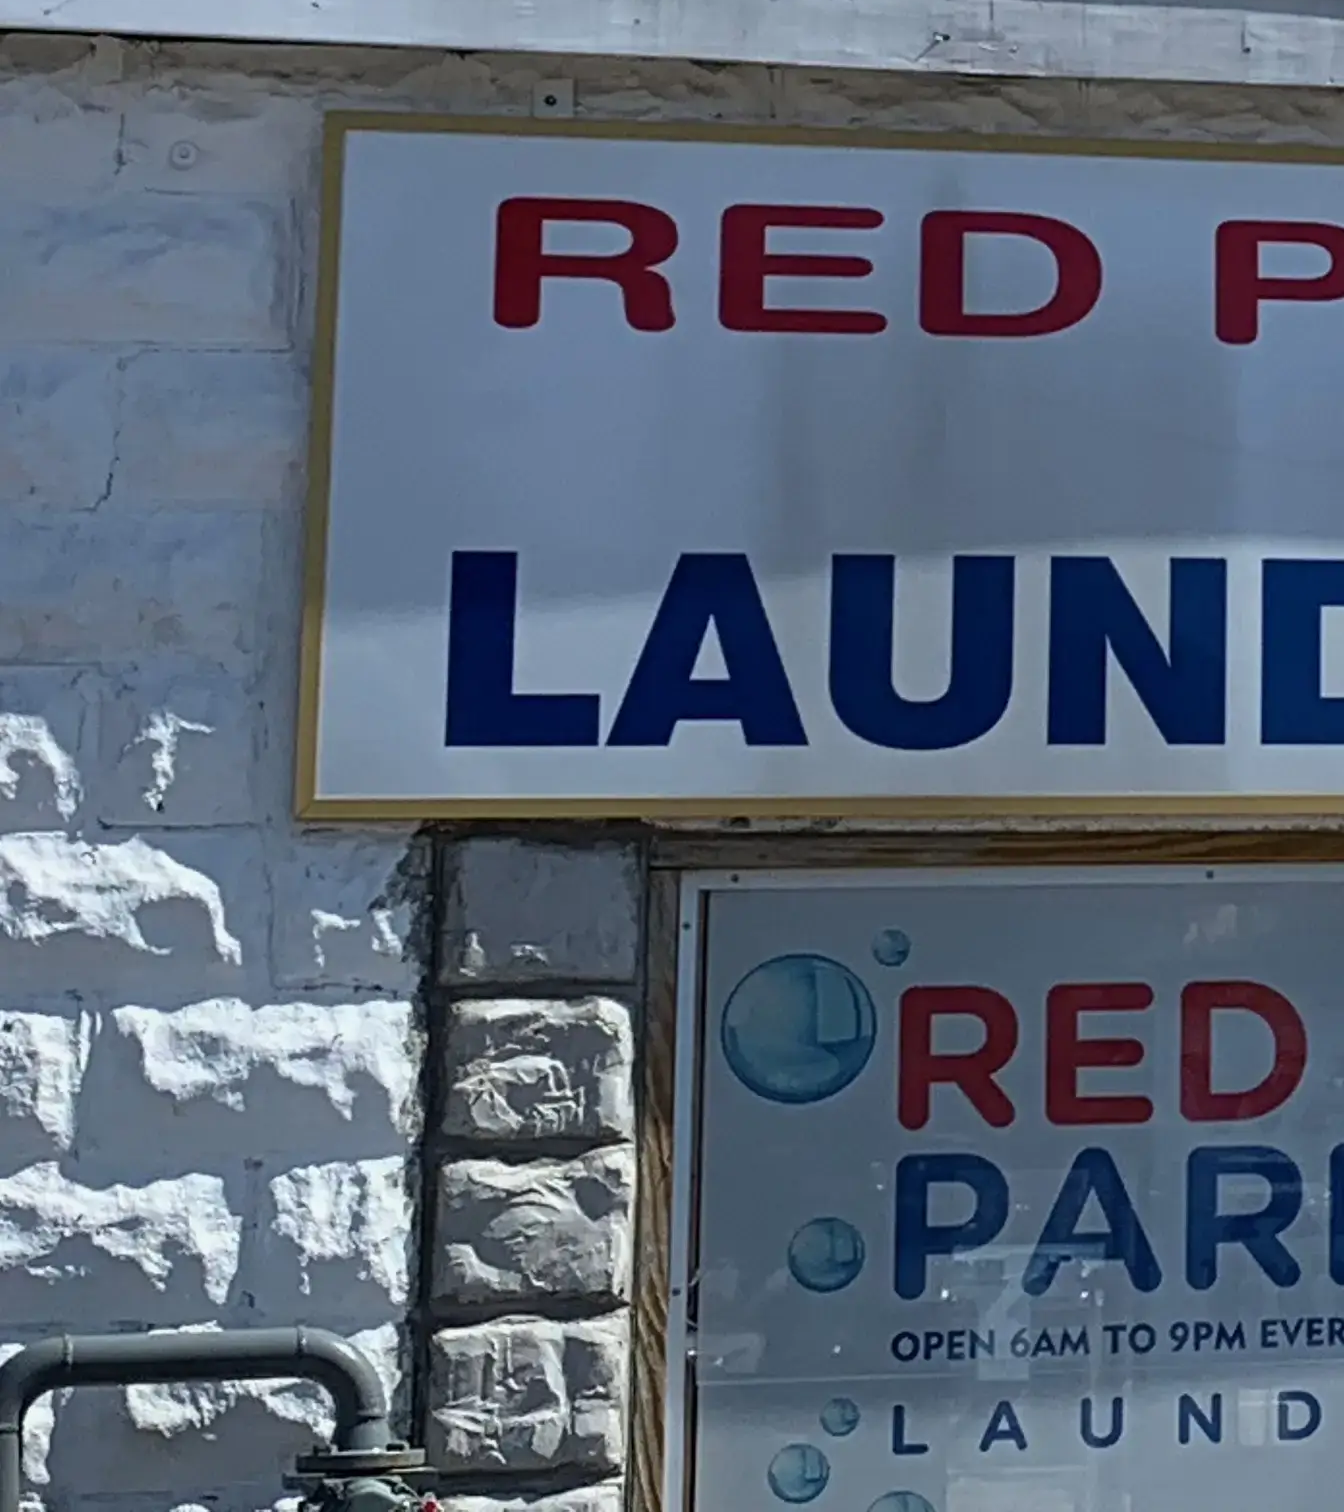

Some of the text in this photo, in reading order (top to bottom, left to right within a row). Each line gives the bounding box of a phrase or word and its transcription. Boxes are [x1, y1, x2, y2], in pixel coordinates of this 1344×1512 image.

[492, 196, 1100, 338] RED
[897, 980, 1307, 1130] RED
[891, 1326, 995, 1363] OPEN
[1010, 1325, 1091, 1359] 6AM
[1104, 1323, 1157, 1355] TO
[1170, 1320, 1247, 1353] 9PM
